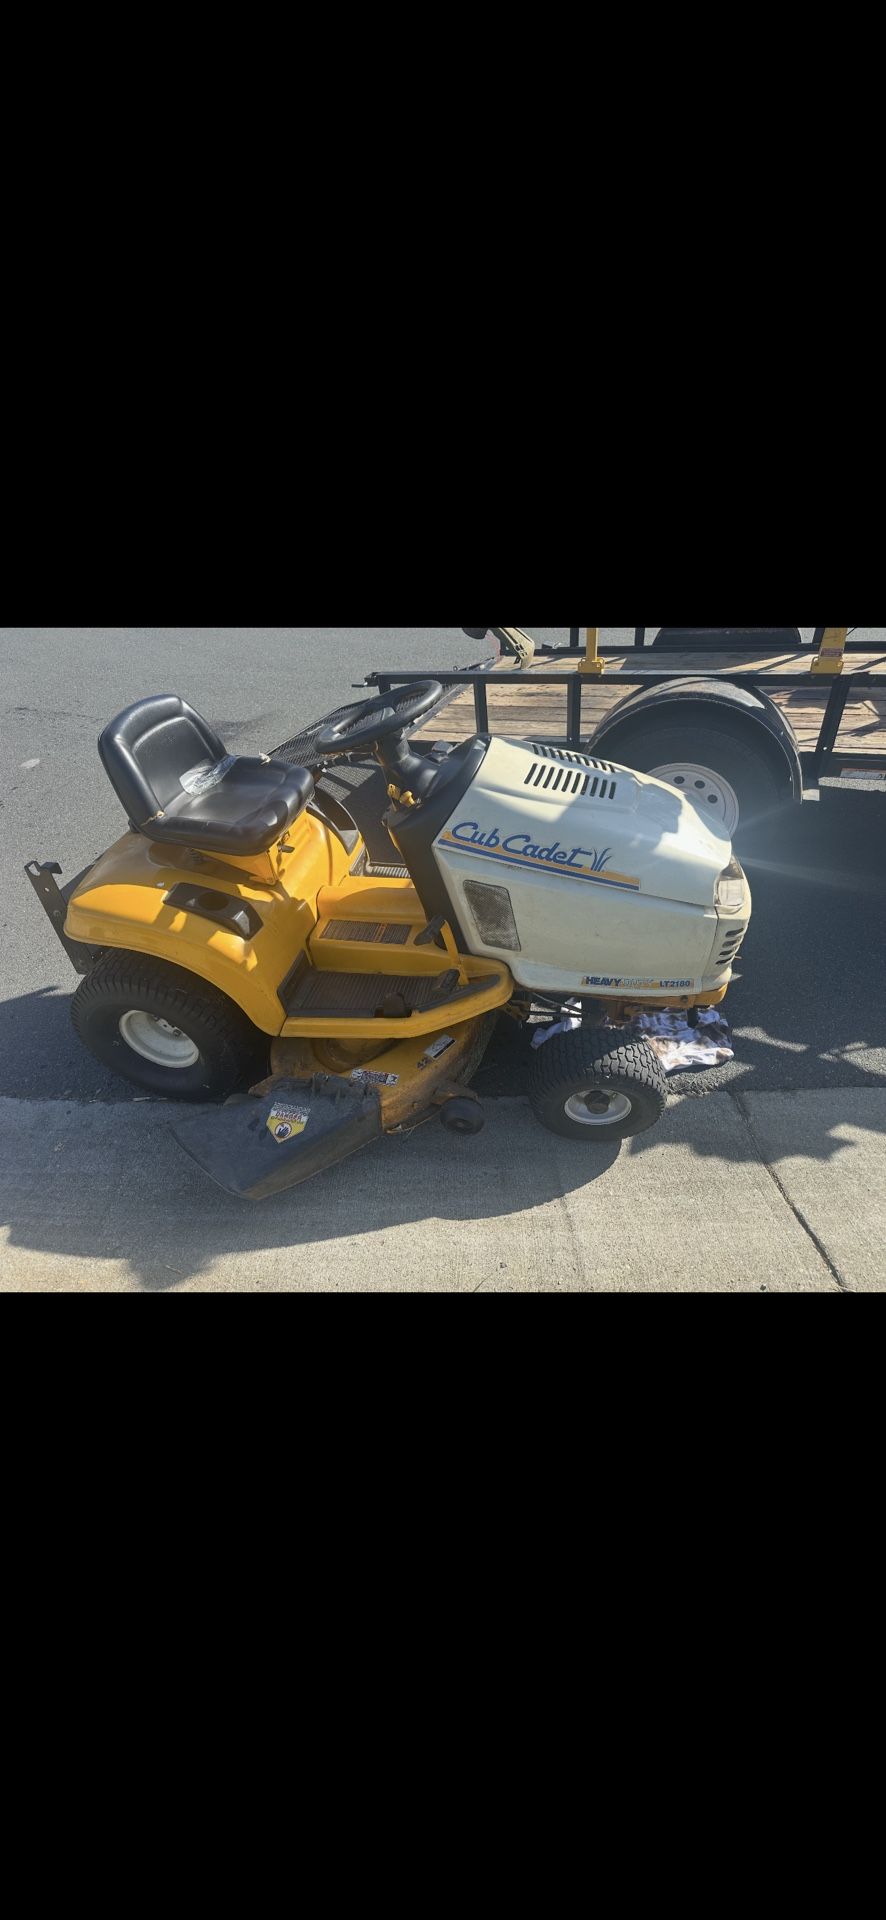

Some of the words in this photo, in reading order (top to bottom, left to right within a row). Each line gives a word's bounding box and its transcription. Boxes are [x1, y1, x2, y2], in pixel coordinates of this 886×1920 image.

[452, 822, 500, 848] Cub
[502, 834, 592, 868] Cadet
[585, 976, 622, 987] HEAVY
